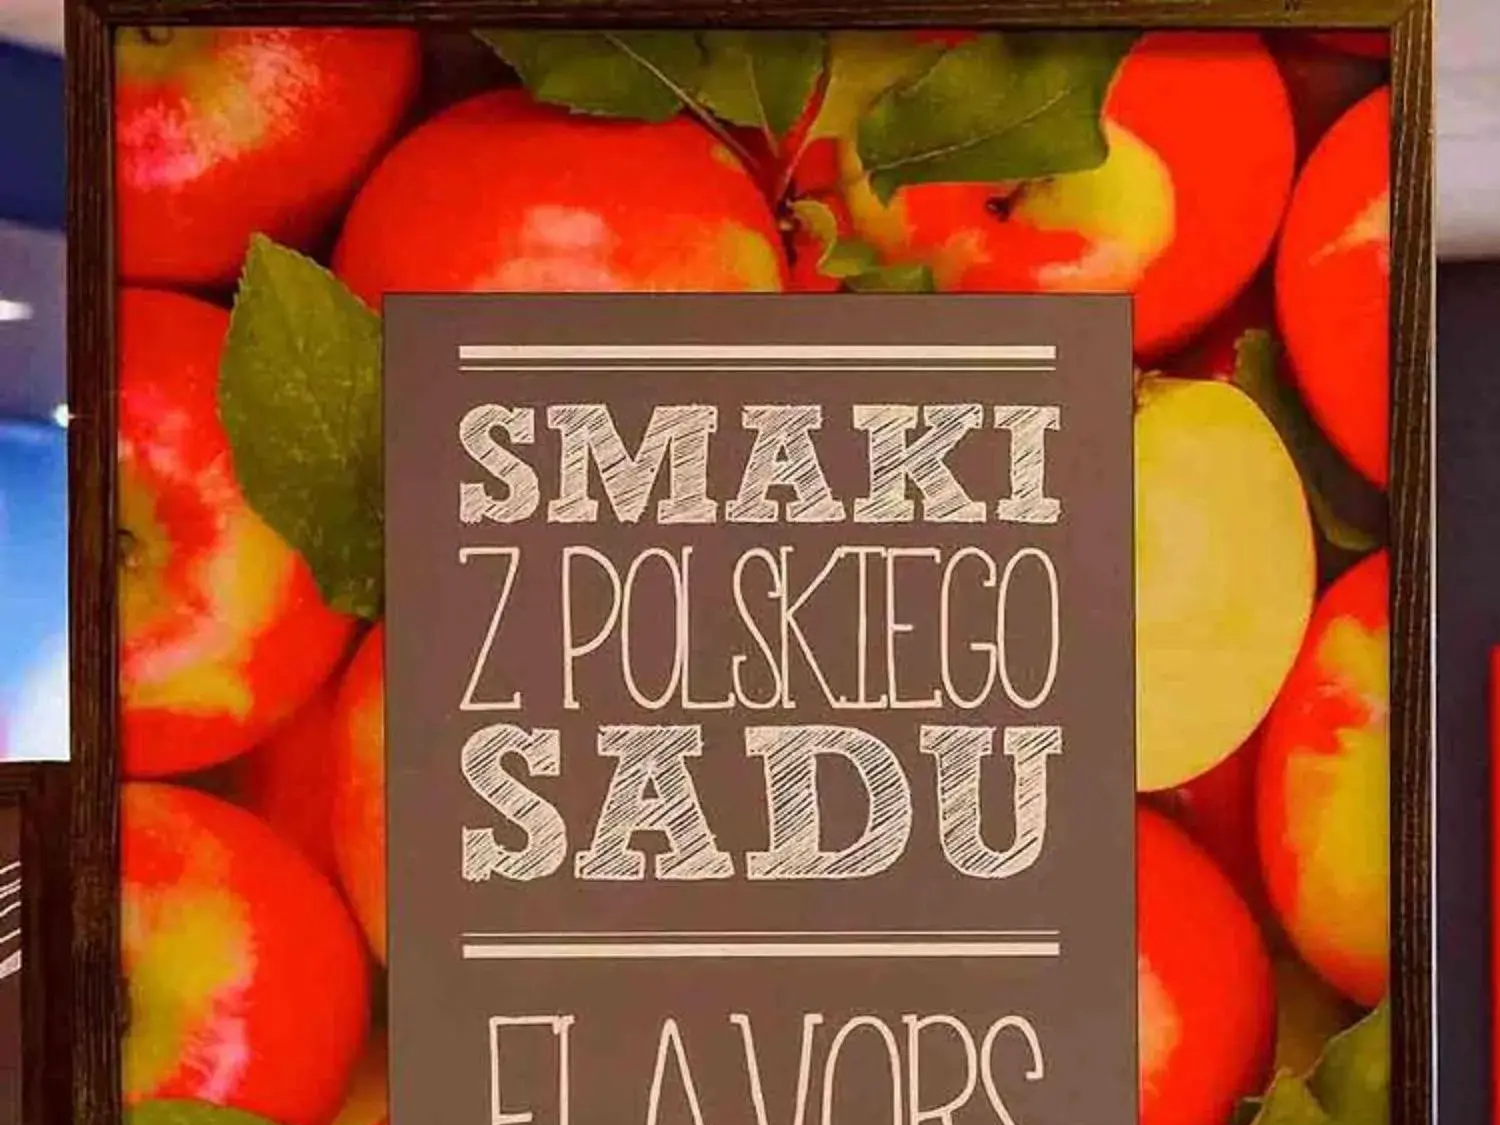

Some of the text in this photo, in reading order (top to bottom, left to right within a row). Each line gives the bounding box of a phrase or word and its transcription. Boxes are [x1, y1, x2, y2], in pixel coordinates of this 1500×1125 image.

[459, 403, 1061, 524] SMAKI
[459, 545, 1059, 711] Z POLSKIEGO
[461, 723, 1062, 881] SADU
